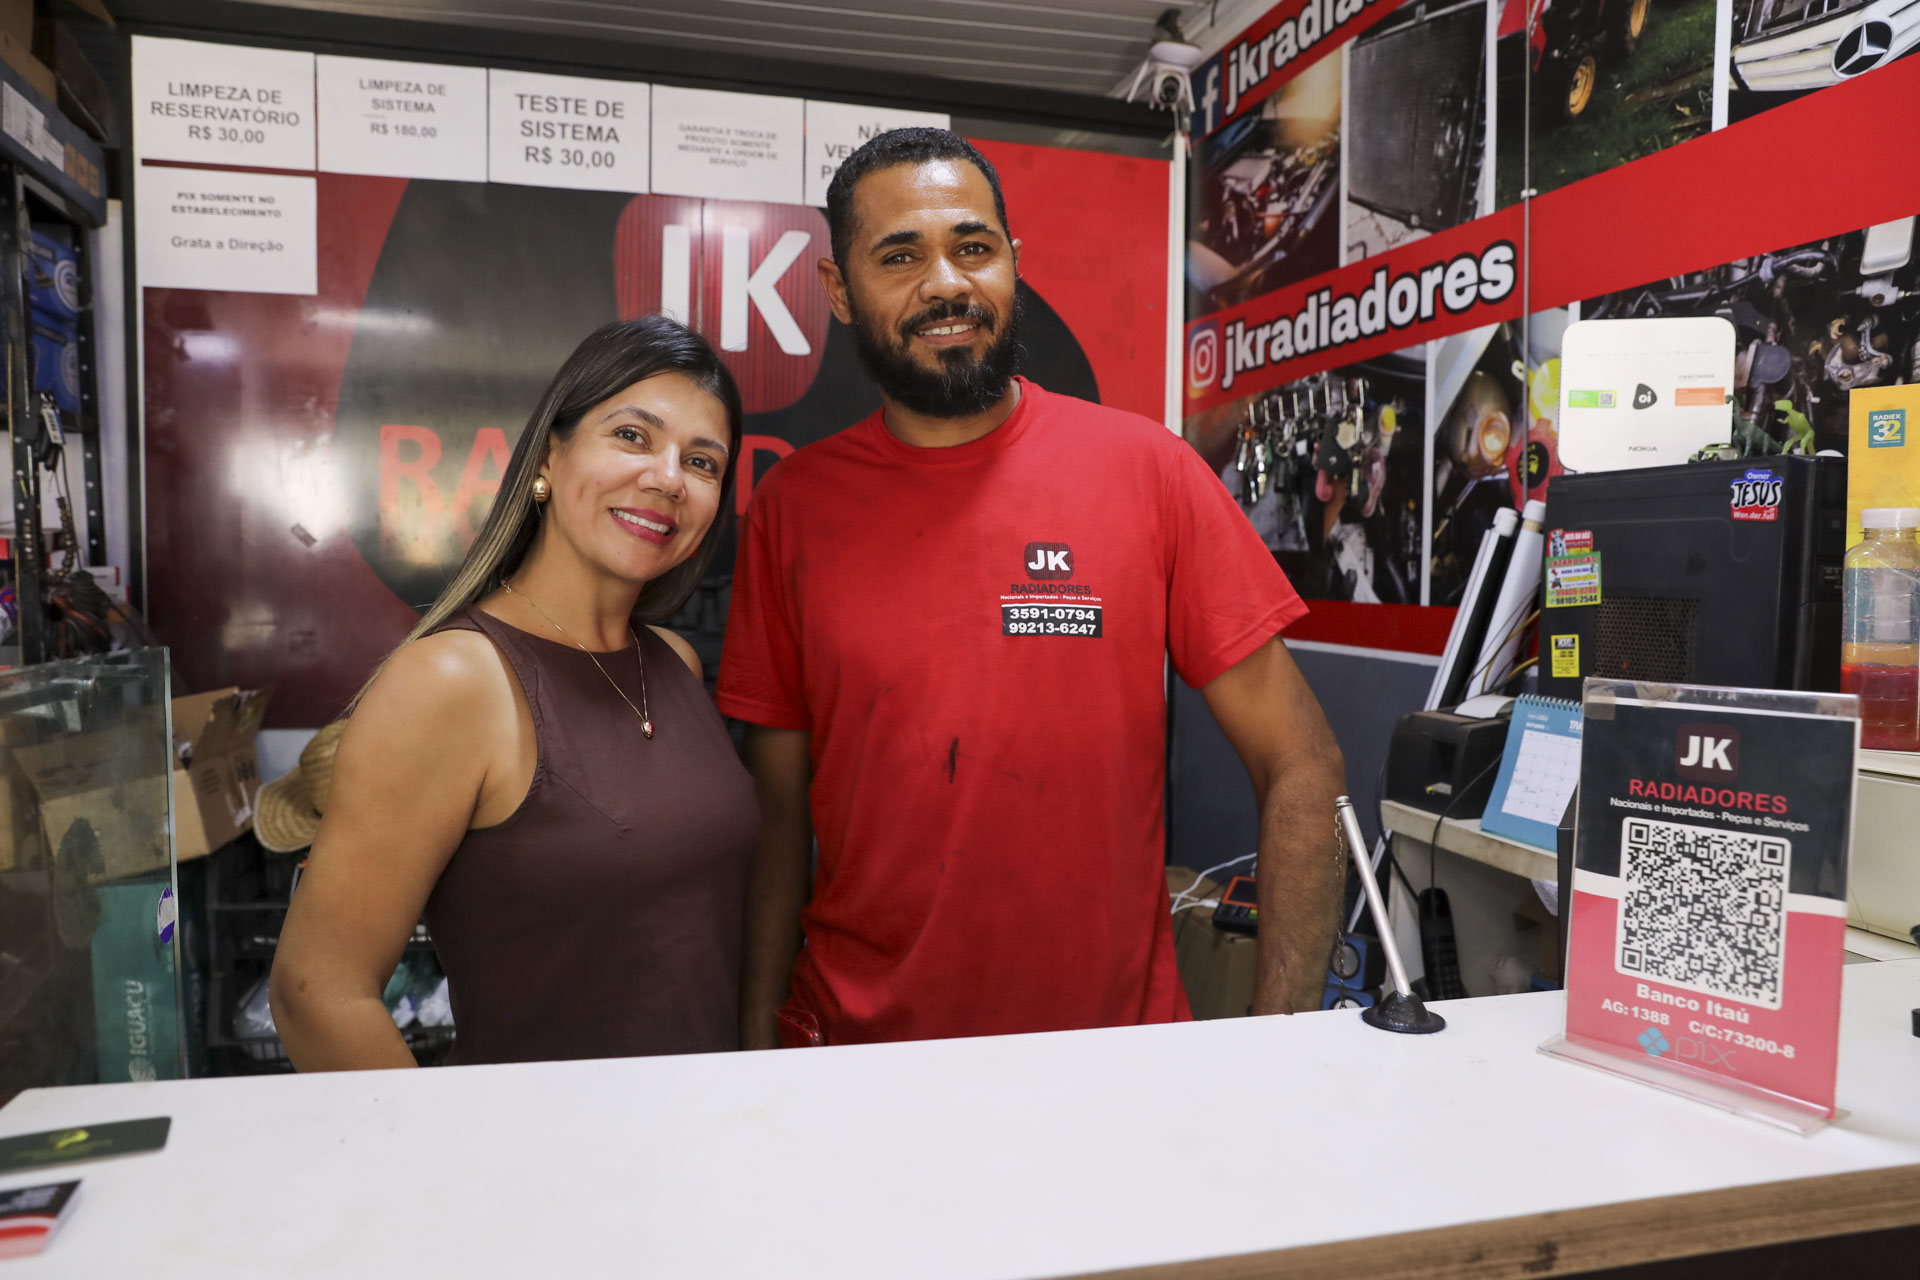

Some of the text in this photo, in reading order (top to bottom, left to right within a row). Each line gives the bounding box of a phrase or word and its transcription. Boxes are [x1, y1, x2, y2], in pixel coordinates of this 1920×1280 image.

[1225, 0, 1376, 116] jkradia
[168, 82, 282, 104] LIMPEZA DE
[359, 78, 446, 96] LIMPEZA DE
[151, 101, 300, 126] RESERVATÓRIO
[371, 98, 435, 113] SISTEMA
[516, 93, 624, 119] TESTE DE
[189, 125, 265, 144] R$ 30,00
[370, 122, 388, 135] R$
[520, 120, 620, 143] SISTEMA
[525, 145, 615, 169] R$ 30,00
[177, 192, 275, 204] PIX SOMENTE NO
[171, 205, 282, 218] ESTABELECIMENTO
[171, 235, 284, 252] Grata a Direção
[1221, 243, 1516, 390] jkradiadores
[1872, 413, 1902, 421] RADIEX
[1873, 420, 1902, 441] 32
[1747, 472, 1770, 480] Owner
[1733, 481, 1781, 508] JESUS
[1028, 549, 1071, 571] JK
[1011, 584, 1092, 594] RADIADORES
[1009, 608, 1096, 621] 3591-0794
[1009, 622, 1096, 635] 99213-6247
[1679, 735, 1734, 772] JK
[1628, 778, 1788, 814] RADIADORES
[1610, 797, 1653, 812] Nacionais
[1661, 803, 1715, 820] Importados
[1721, 811, 1753, 825] Peças
[1754, 818, 1762, 826] e
[1763, 816, 1810, 832] Serviços
[1636, 983, 1750, 1025] Banco Itaú
[1675, 1036, 1736, 1071] pix
